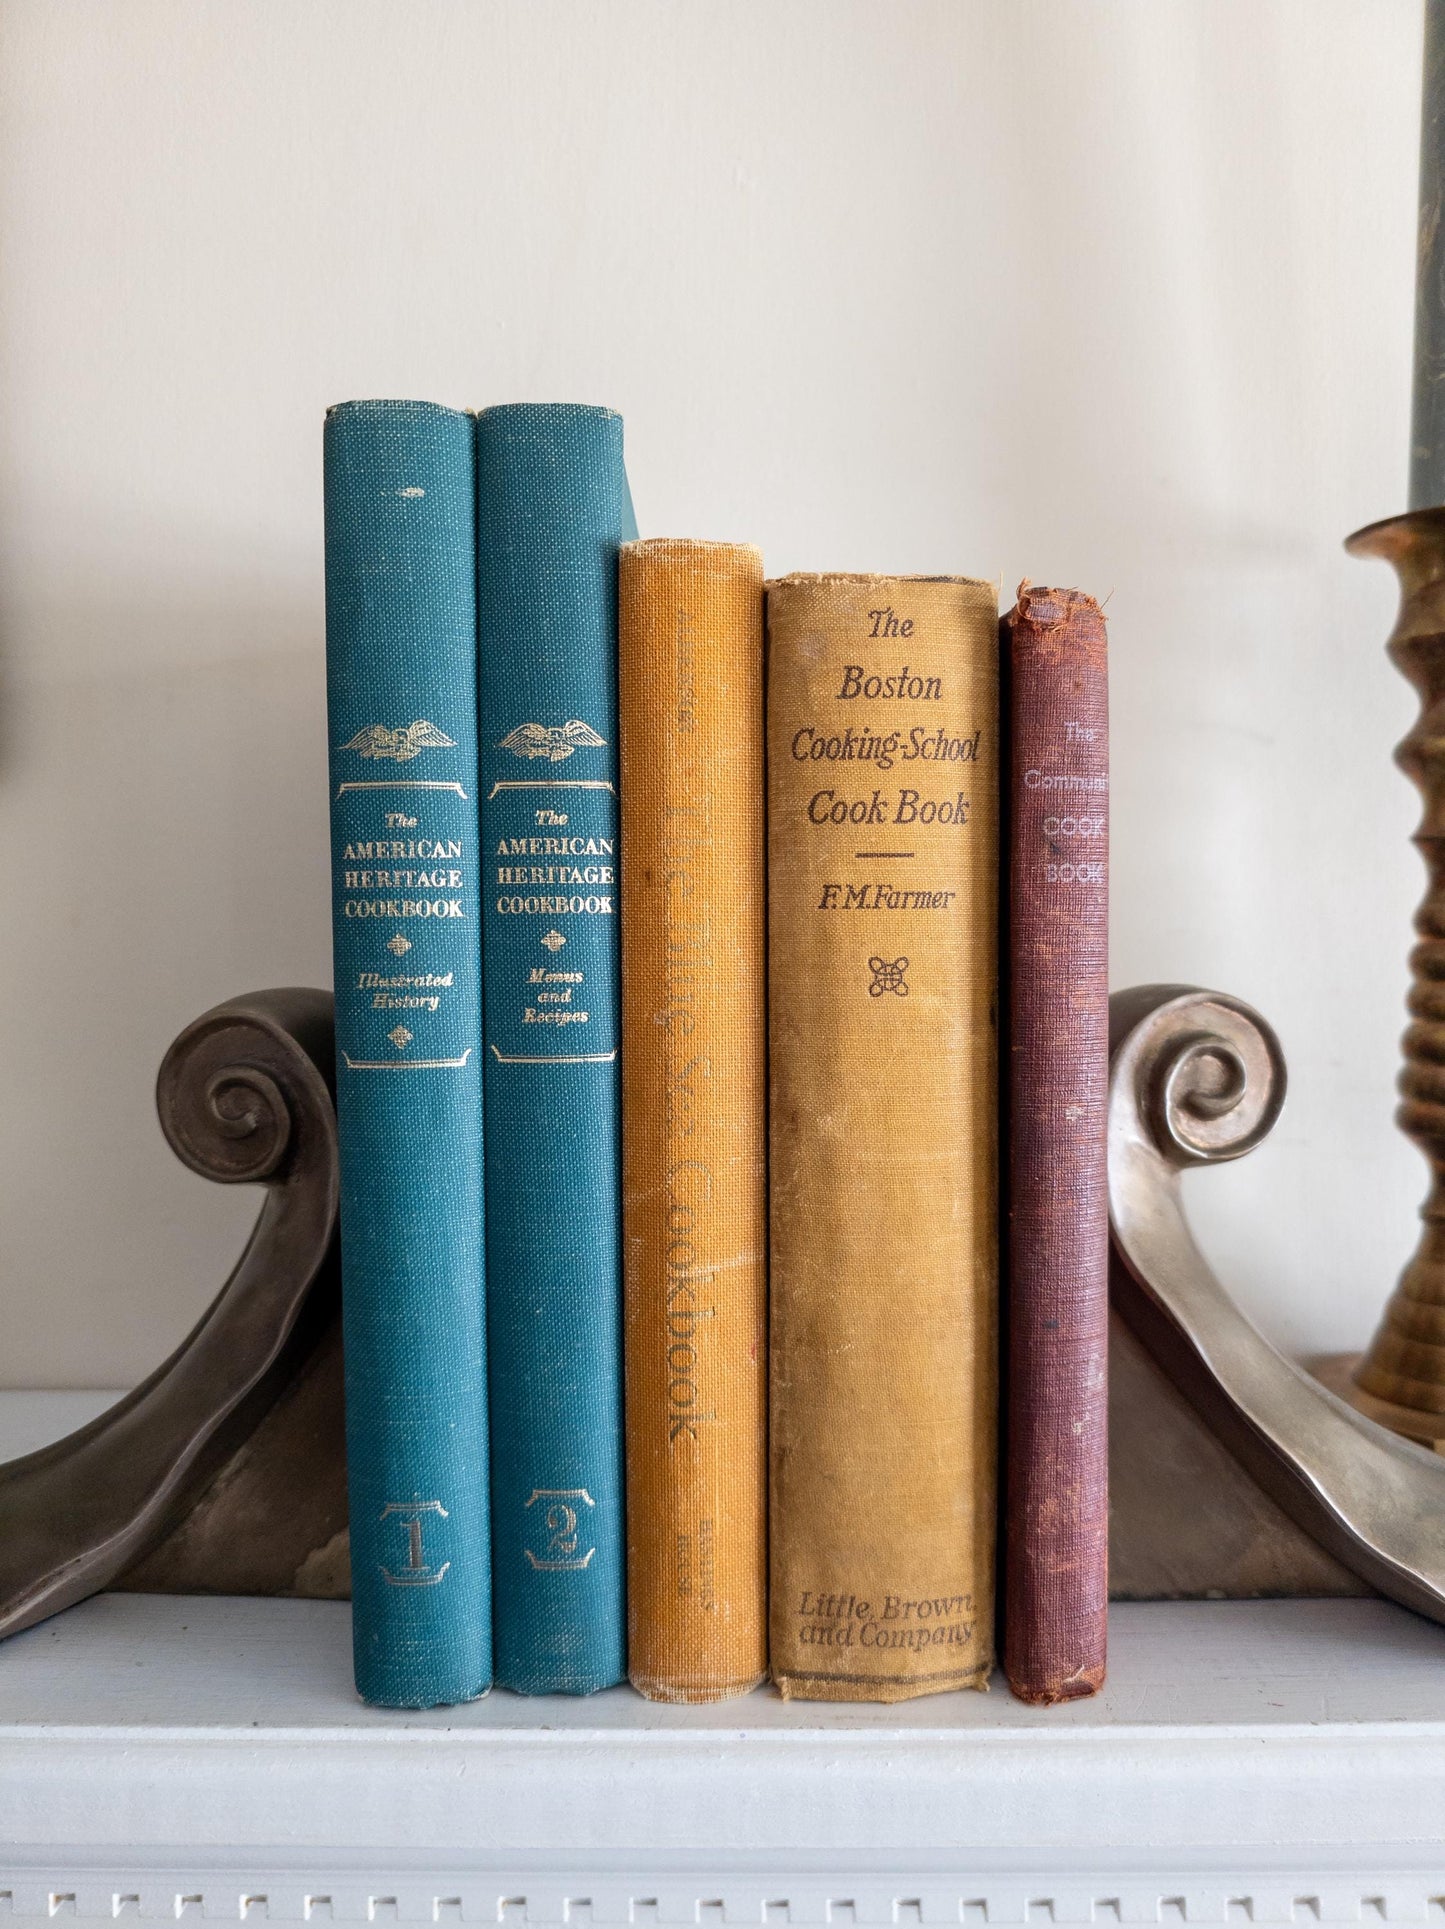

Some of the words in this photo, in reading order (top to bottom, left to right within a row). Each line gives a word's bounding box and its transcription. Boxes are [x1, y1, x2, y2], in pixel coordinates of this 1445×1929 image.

[868, 607, 914, 638] The
[836, 666, 943, 700] Boston
[792, 727, 981, 769] Cooking-School
[536, 810, 568, 826] The
[807, 793, 886, 826] Cook
[893, 790, 970, 826] Book
[385, 812, 417, 829] The
[344, 840, 463, 860] AMERICAN
[496, 838, 613, 856] AMERICAN
[663, 794, 715, 898] The
[344, 870, 464, 888] HERITAGE
[496, 867, 614, 885] HERITAGE
[344, 900, 463, 918] COOKBOOK
[496, 897, 614, 915] COOKBOOK
[356, 972, 454, 989] Illustrated
[525, 968, 584, 984] Menus
[665, 916, 714, 1037] Blue
[371, 993, 440, 1012] History
[537, 987, 572, 1003] and
[521, 1007, 590, 1027] Recipes
[666, 1054, 712, 1138] Sea
[668, 1159, 717, 1443] Cookbook
[547, 1504, 577, 1553] 2
[400, 1520, 431, 1569] 1
[799, 1624, 853, 1647] and
[859, 1619, 976, 1653] Company
